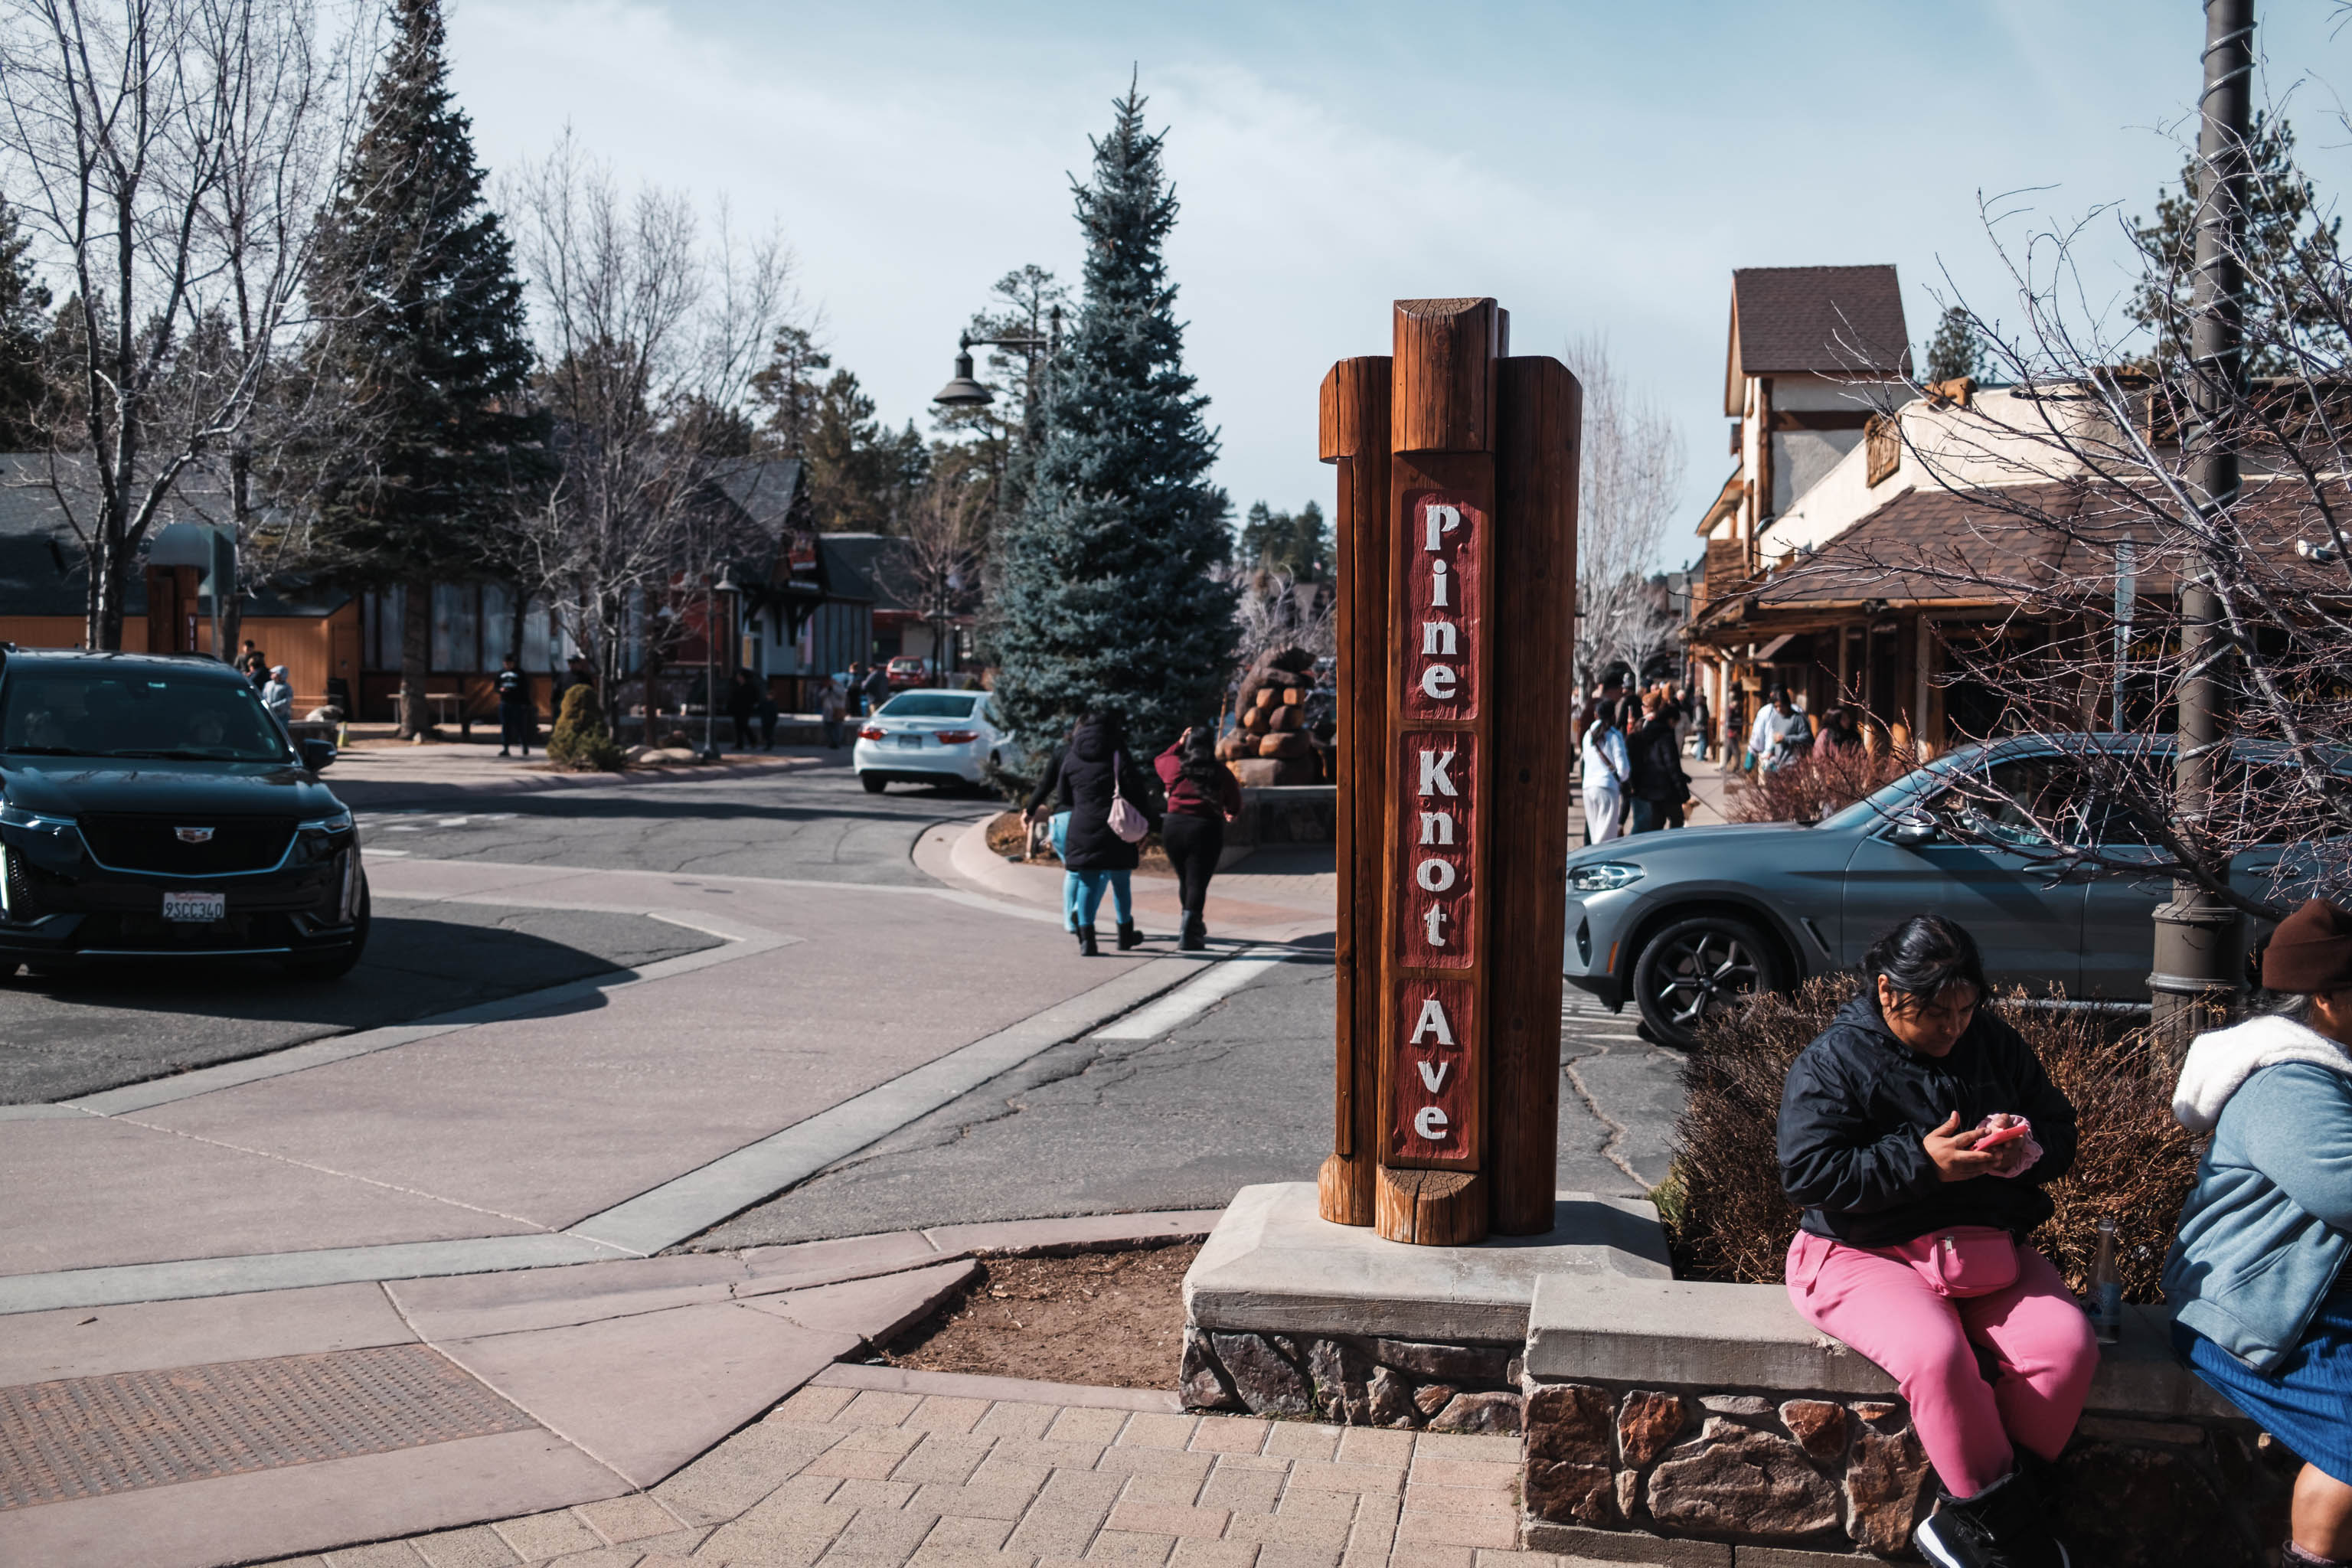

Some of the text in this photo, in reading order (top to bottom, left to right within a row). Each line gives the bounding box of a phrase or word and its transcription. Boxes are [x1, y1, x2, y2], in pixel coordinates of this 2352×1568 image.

[165, 901, 223, 919] 9SCC340
[1410, 505, 1460, 1140] Pine Knot Ave
